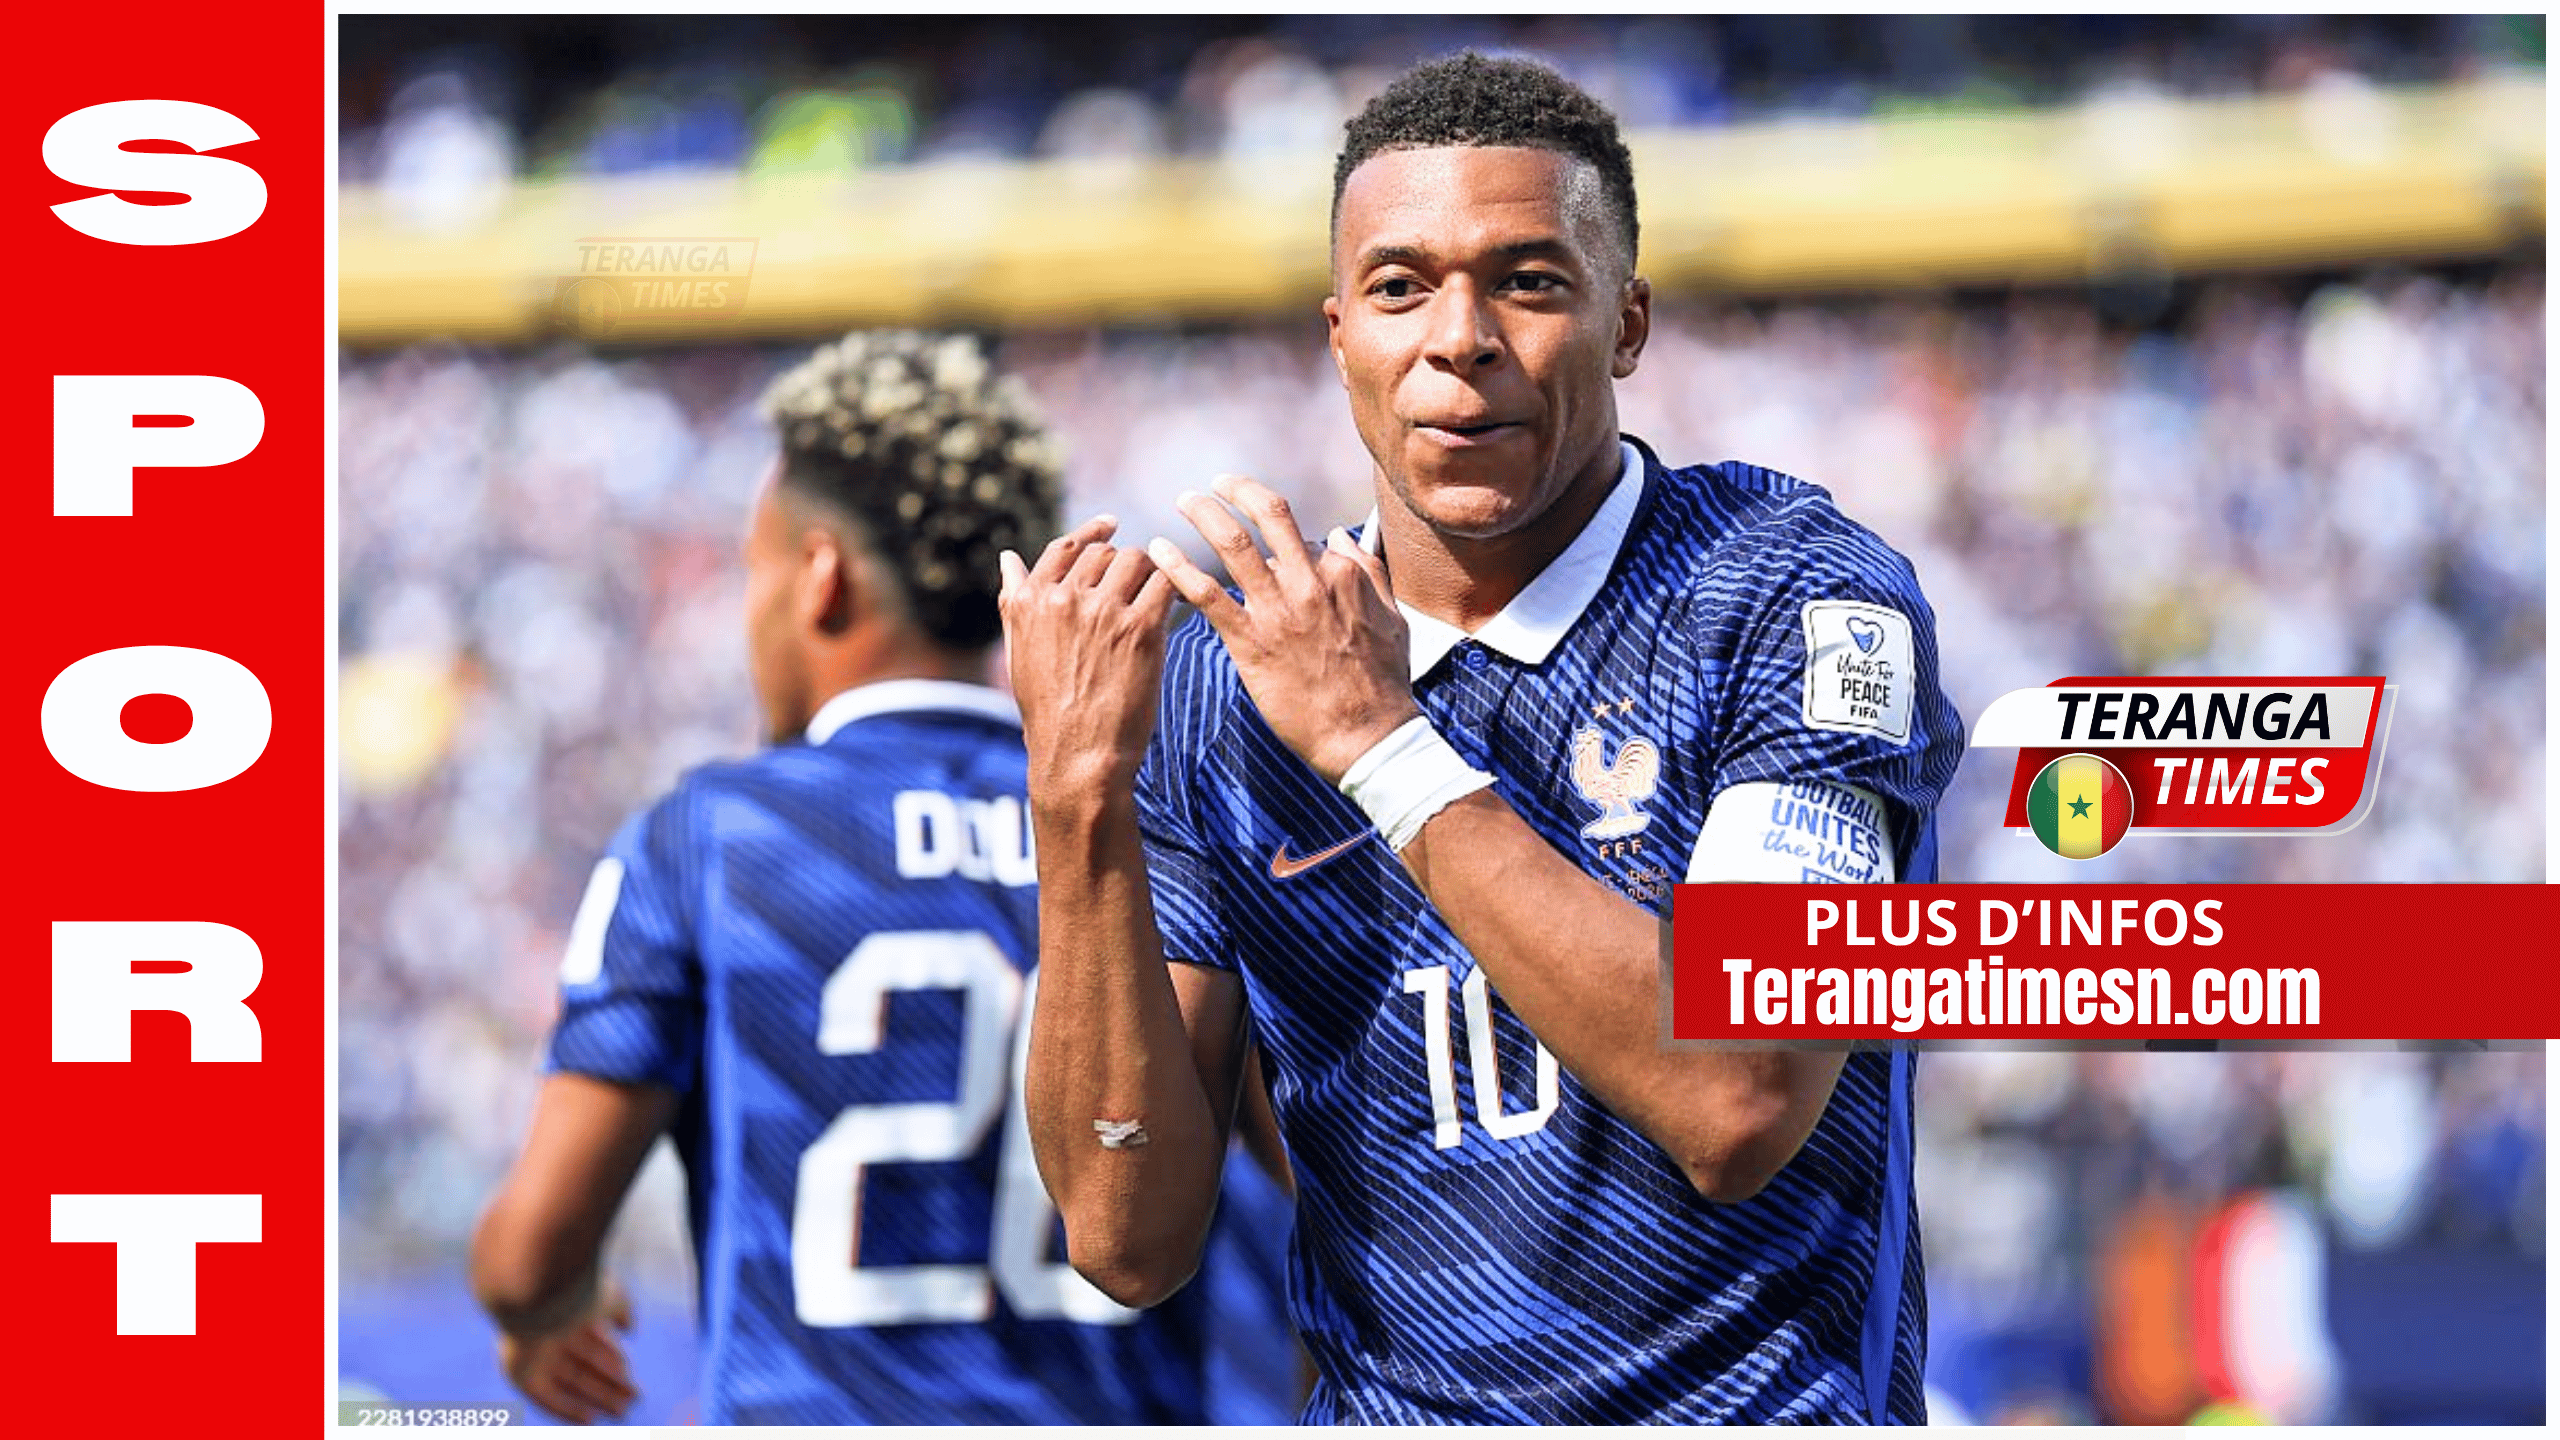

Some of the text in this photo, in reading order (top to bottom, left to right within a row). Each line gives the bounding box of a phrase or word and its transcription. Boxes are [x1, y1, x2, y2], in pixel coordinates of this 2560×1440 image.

[1841, 678, 1891, 708] PEACE
[1850, 704, 1878, 719] FIFA
[1599, 838, 1642, 861] FFF
[1771, 798, 1881, 866] UNITES
[1762, 829, 1811, 857] the
[1817, 842, 1885, 884] Worl
[1403, 963, 1559, 1150] 10
